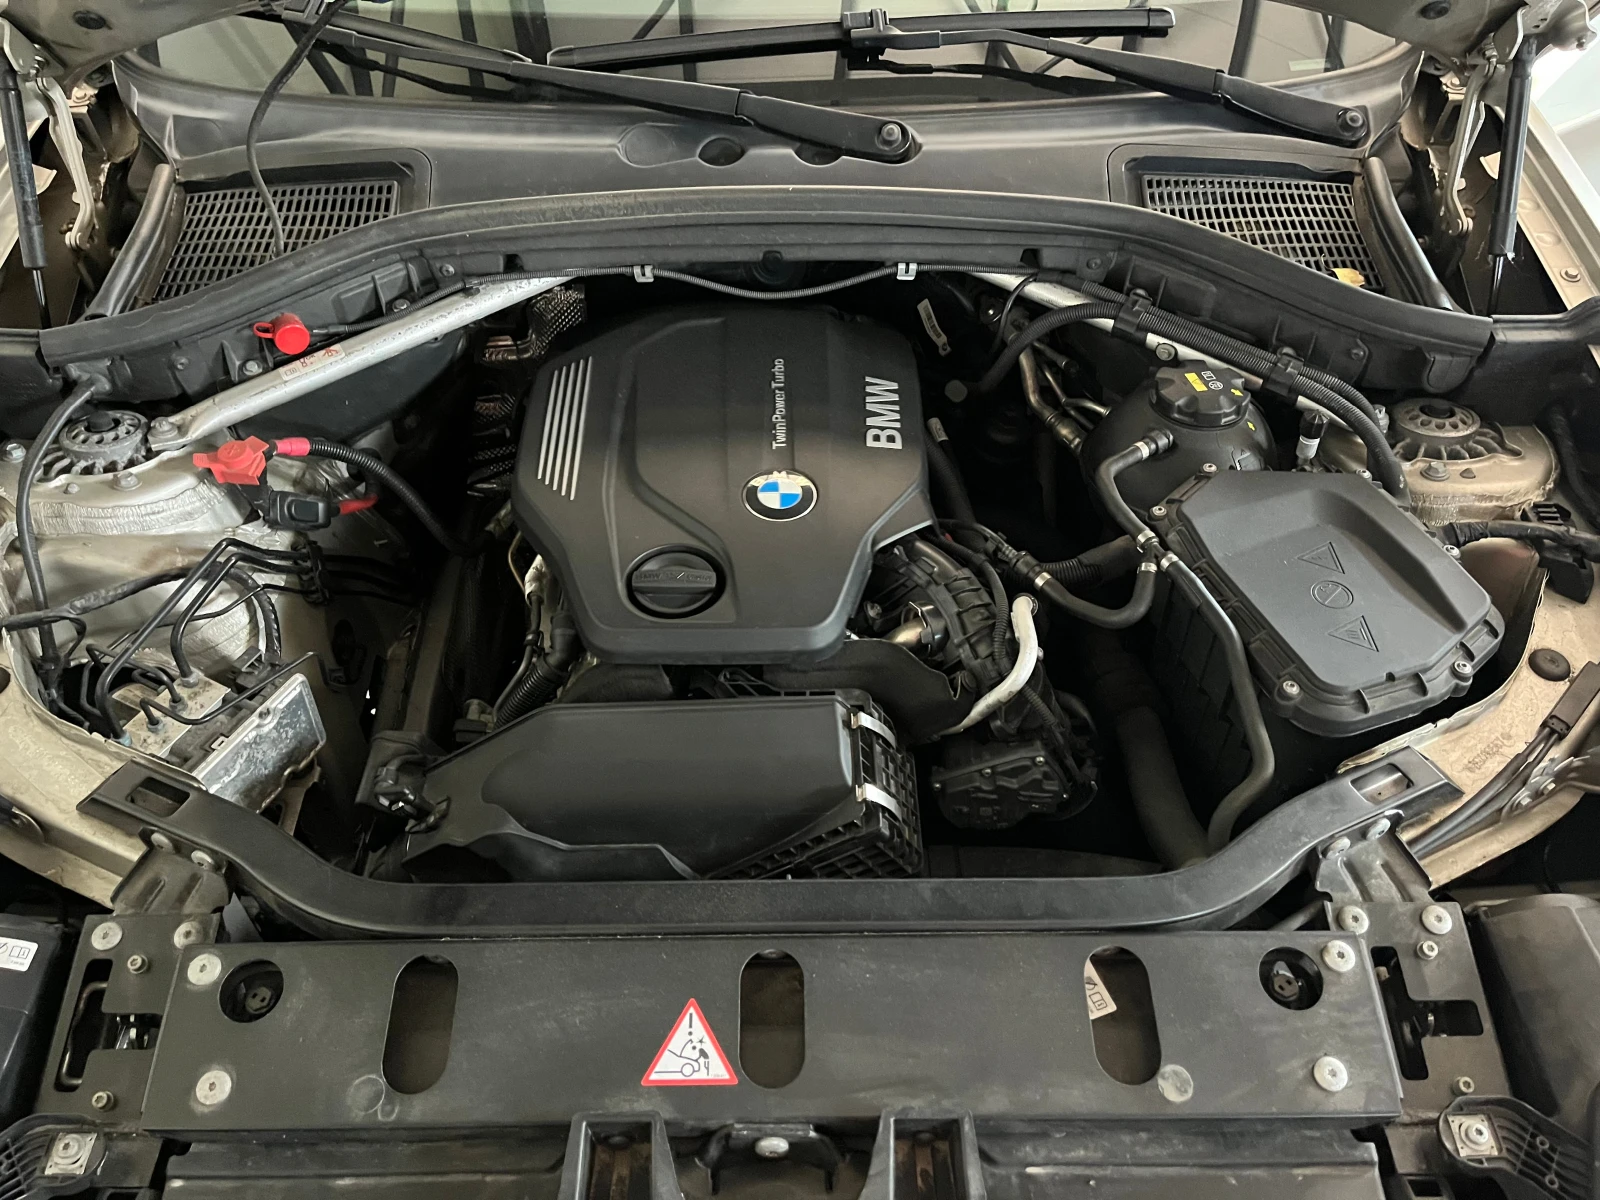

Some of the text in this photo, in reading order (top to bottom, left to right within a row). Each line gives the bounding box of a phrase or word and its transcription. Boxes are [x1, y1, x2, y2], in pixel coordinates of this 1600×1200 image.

[771, 358, 788, 450] TwinPower Turbo
[865, 376, 903, 450] BMW
